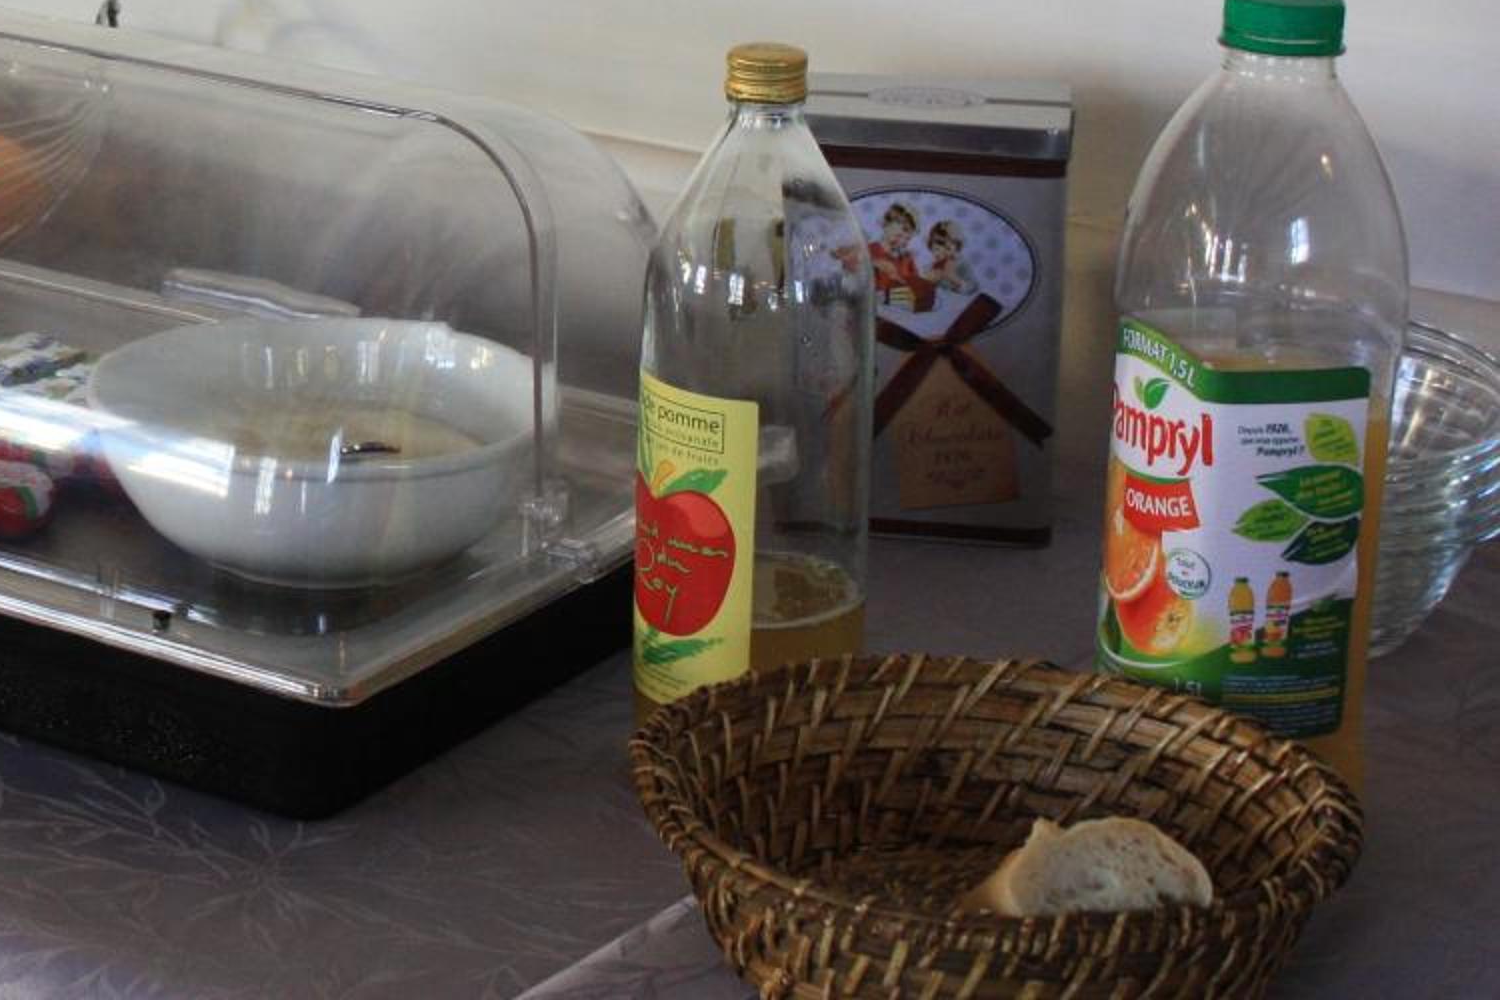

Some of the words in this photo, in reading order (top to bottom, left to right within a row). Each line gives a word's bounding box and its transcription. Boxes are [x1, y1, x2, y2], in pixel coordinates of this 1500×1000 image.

[1123, 327, 1169, 361] FORMAT
[658, 405, 720, 434] pomme
[1125, 487, 1190, 517] ORANGE
